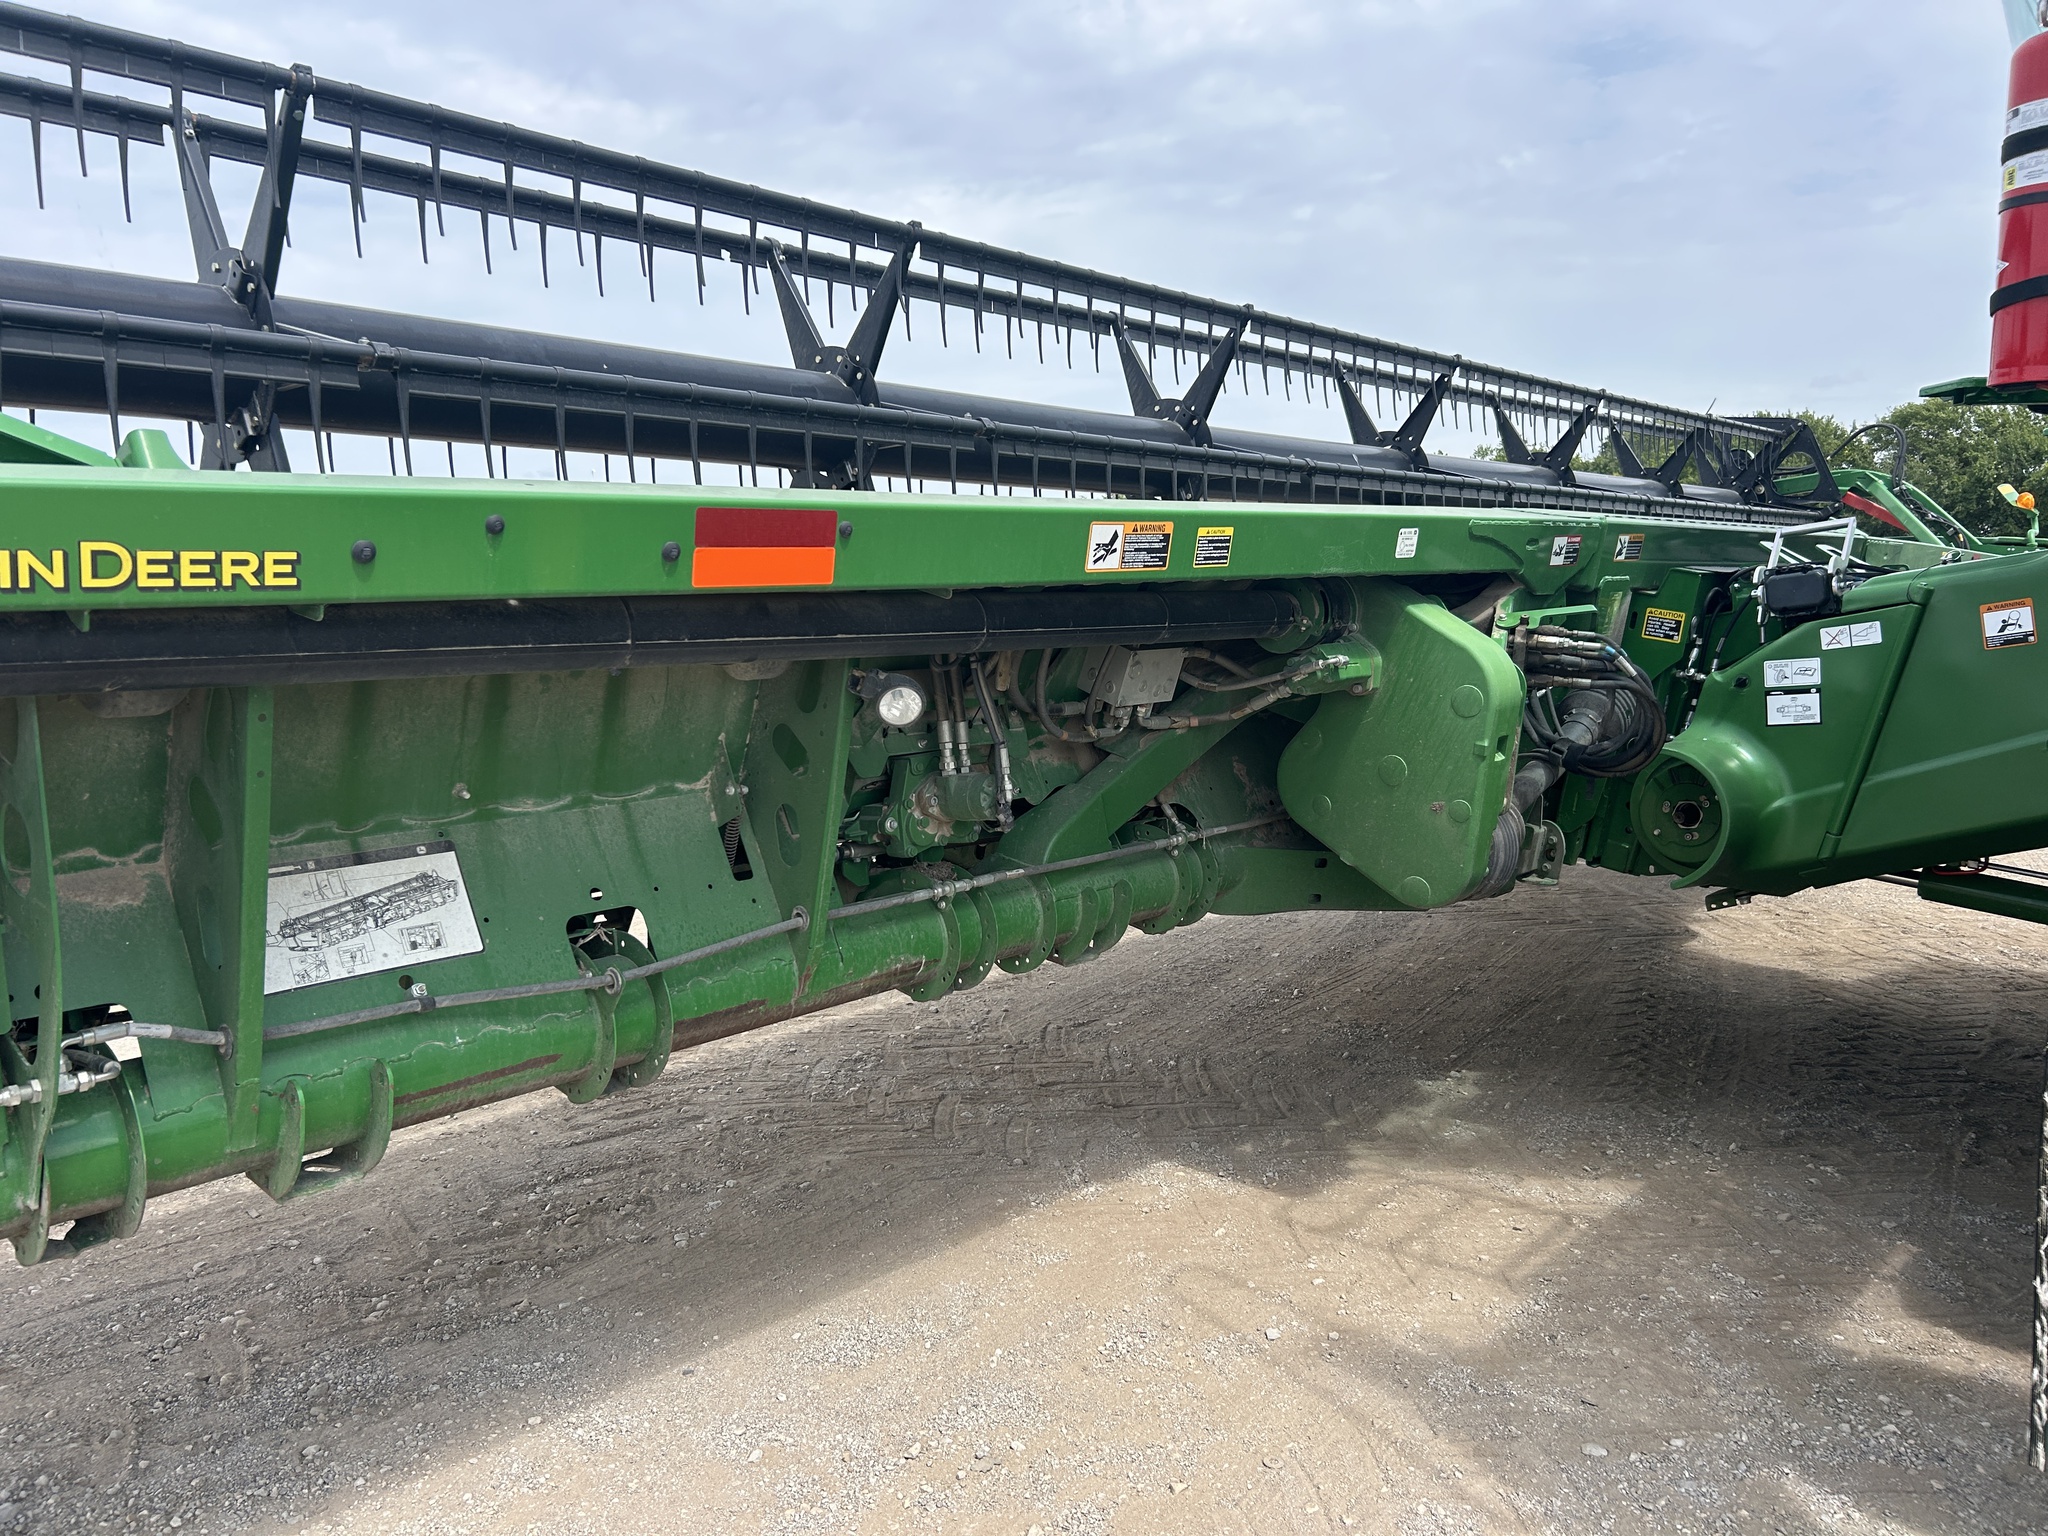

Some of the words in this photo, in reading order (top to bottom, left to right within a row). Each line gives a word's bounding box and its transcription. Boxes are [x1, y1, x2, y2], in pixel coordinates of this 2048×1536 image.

[1139, 524, 1166, 532] WARNING
[79, 540, 301, 591] DEERE
[1994, 600, 2026, 609] WARNING
[1654, 610, 1683, 619] CAUTION
